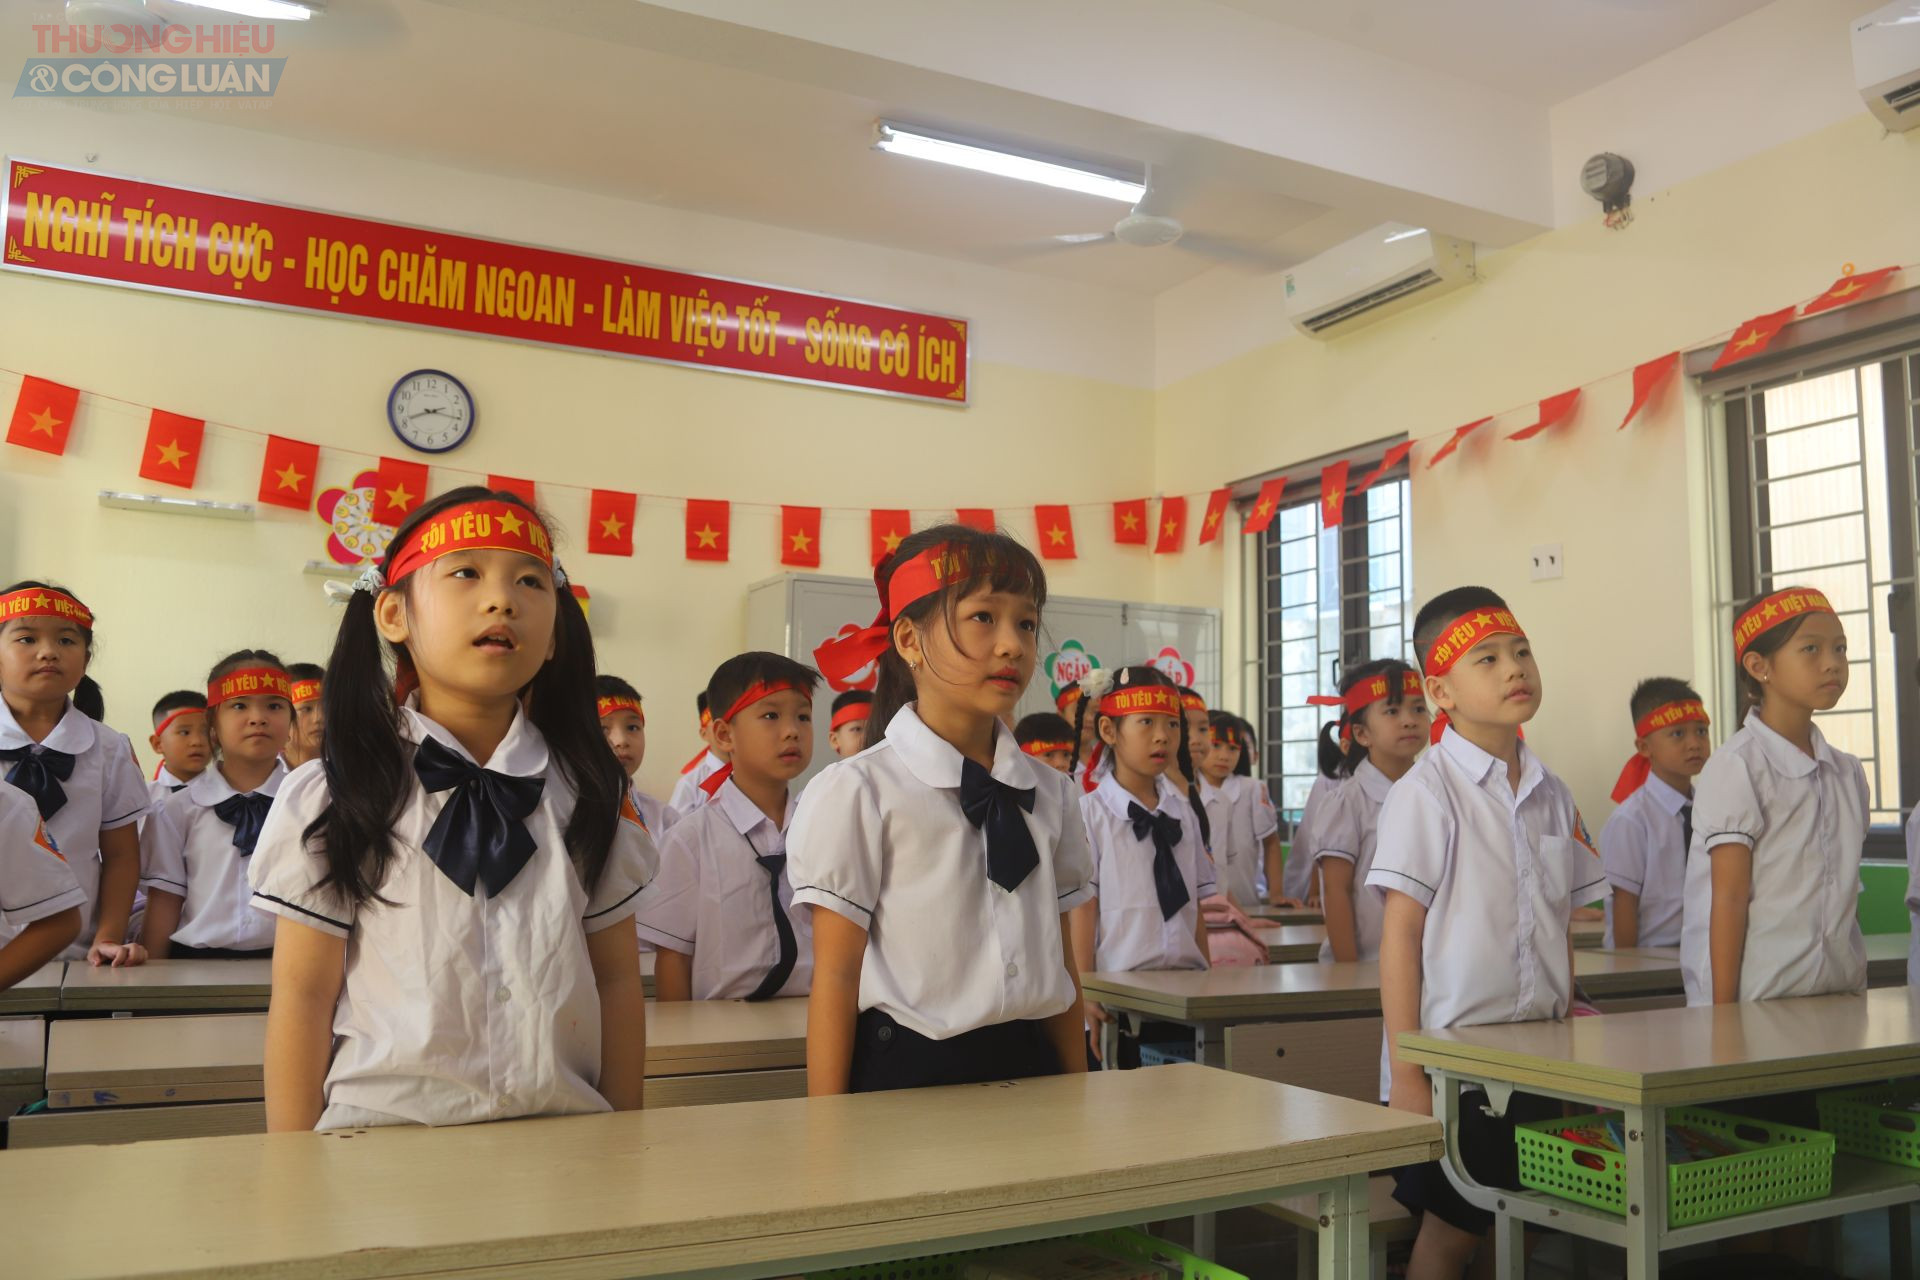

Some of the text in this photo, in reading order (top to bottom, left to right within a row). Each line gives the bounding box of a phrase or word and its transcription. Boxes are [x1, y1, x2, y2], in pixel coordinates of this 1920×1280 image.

[23, 191, 116, 259] NGHĨ
[122, 198, 199, 272] TÍCH
[207, 222, 274, 290] CỰC
[305, 236, 368, 304] HỌC
[378, 243, 467, 311] CHĂM
[475, 263, 576, 327] NGOAN
[602, 275, 661, 340] LÀM
[670, 289, 728, 357] VIỆC
[735, 295, 780, 357] TỐT
[804, 306, 871, 371] SỐNG
[879, 324, 910, 378] CÓ
[917, 325, 956, 384] ÍCH
[412, 381, 421, 392] 11
[427, 379, 437, 389] 12
[401, 391, 411, 400] 10
[453, 395, 460, 405] 2
[397, 405, 404, 414] 9
[402, 419, 408, 429] 8
[452, 423, 458, 432] 4
[412, 430, 418, 440] 7
[427, 435, 433, 445] 6
[442, 432, 448, 442] 5
[451, 511, 491, 540] YÊU
[9, 596, 30, 614] YÊU
[1742, 613, 1762, 638] YÊU
[1779, 594, 1806, 613] VIỆT
[1434, 642, 1453, 666] TÔI
[1448, 622, 1475, 650] YÊU
[222, 678, 234, 696] TÔI
[236, 674, 258, 691] YÊU
[1371, 679, 1386, 696] TÔI
[295, 684, 312, 699] YÊU
[1116, 692, 1130, 708] TÔI
[1132, 690, 1152, 706] YÊU
